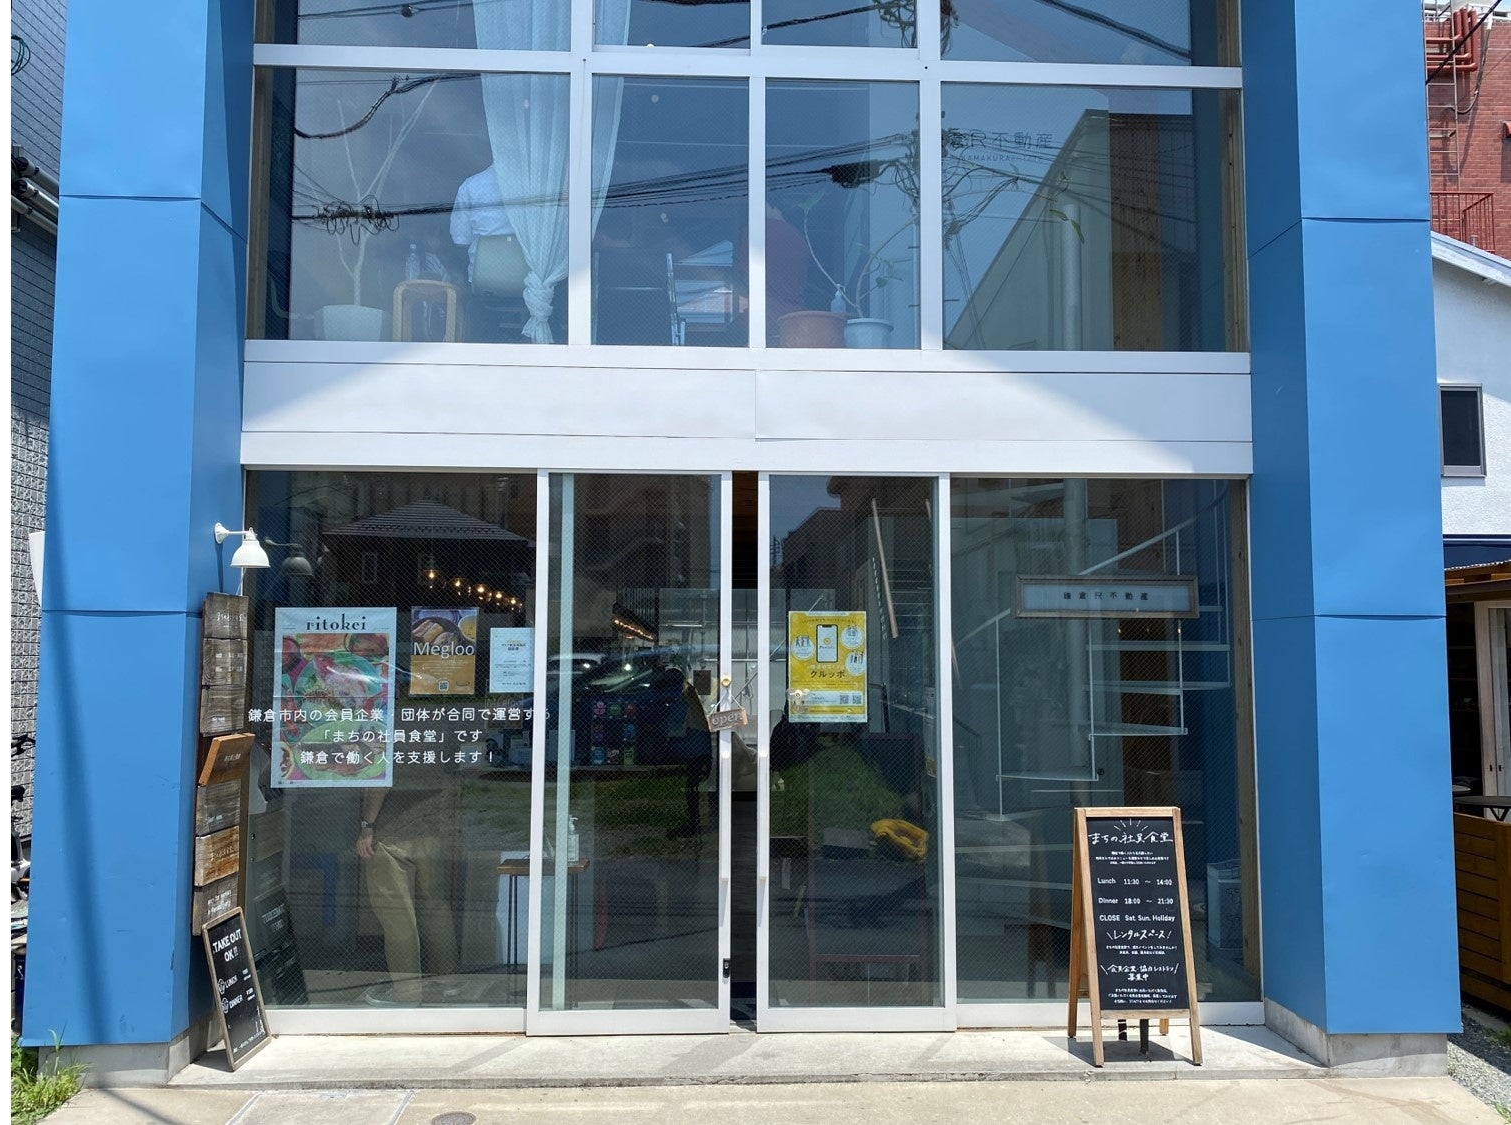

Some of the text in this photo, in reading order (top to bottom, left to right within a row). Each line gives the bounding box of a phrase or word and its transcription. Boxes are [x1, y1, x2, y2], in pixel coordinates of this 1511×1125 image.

[305, 613, 366, 630] ritokei
[413, 642, 475, 659] Megloo
[323, 729, 483, 743] 「まちの社員食堂」です
[1088, 831, 1174, 845] まちの社員食堂
[1156, 878, 1173, 886] 14:00
[1157, 897, 1174, 905] 21:30
[1099, 914, 1120, 922] CLOSE
[1152, 914, 1176, 923] Holiday
[212, 928, 242, 953] TAKE OUT
